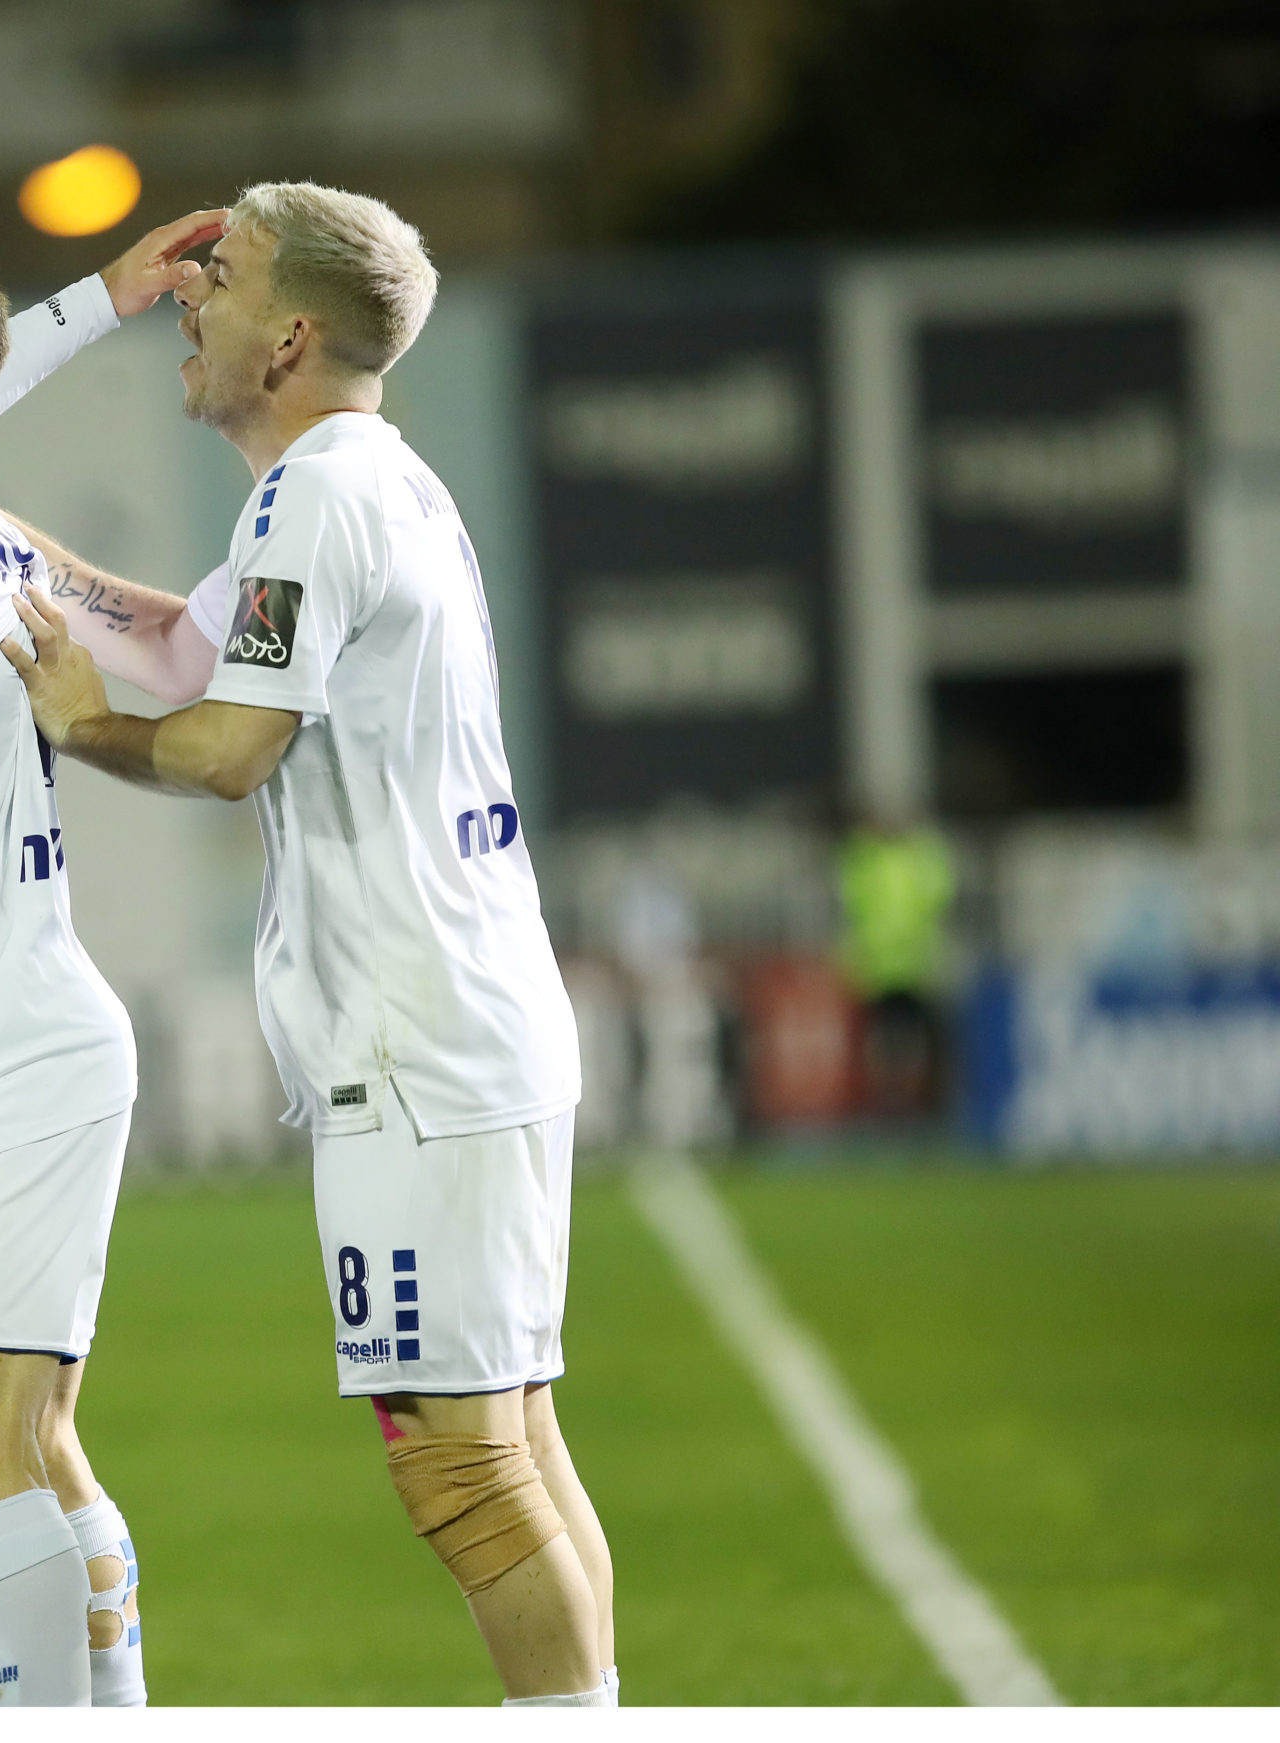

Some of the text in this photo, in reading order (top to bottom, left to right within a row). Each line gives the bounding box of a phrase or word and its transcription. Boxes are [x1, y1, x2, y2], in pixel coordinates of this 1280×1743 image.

[45, 298, 66, 326] cap
[457, 803, 518, 859] no
[338, 1246, 371, 1330] 8
[337, 1338, 390, 1360] capelli
[354, 1356, 391, 1364] SPORT
